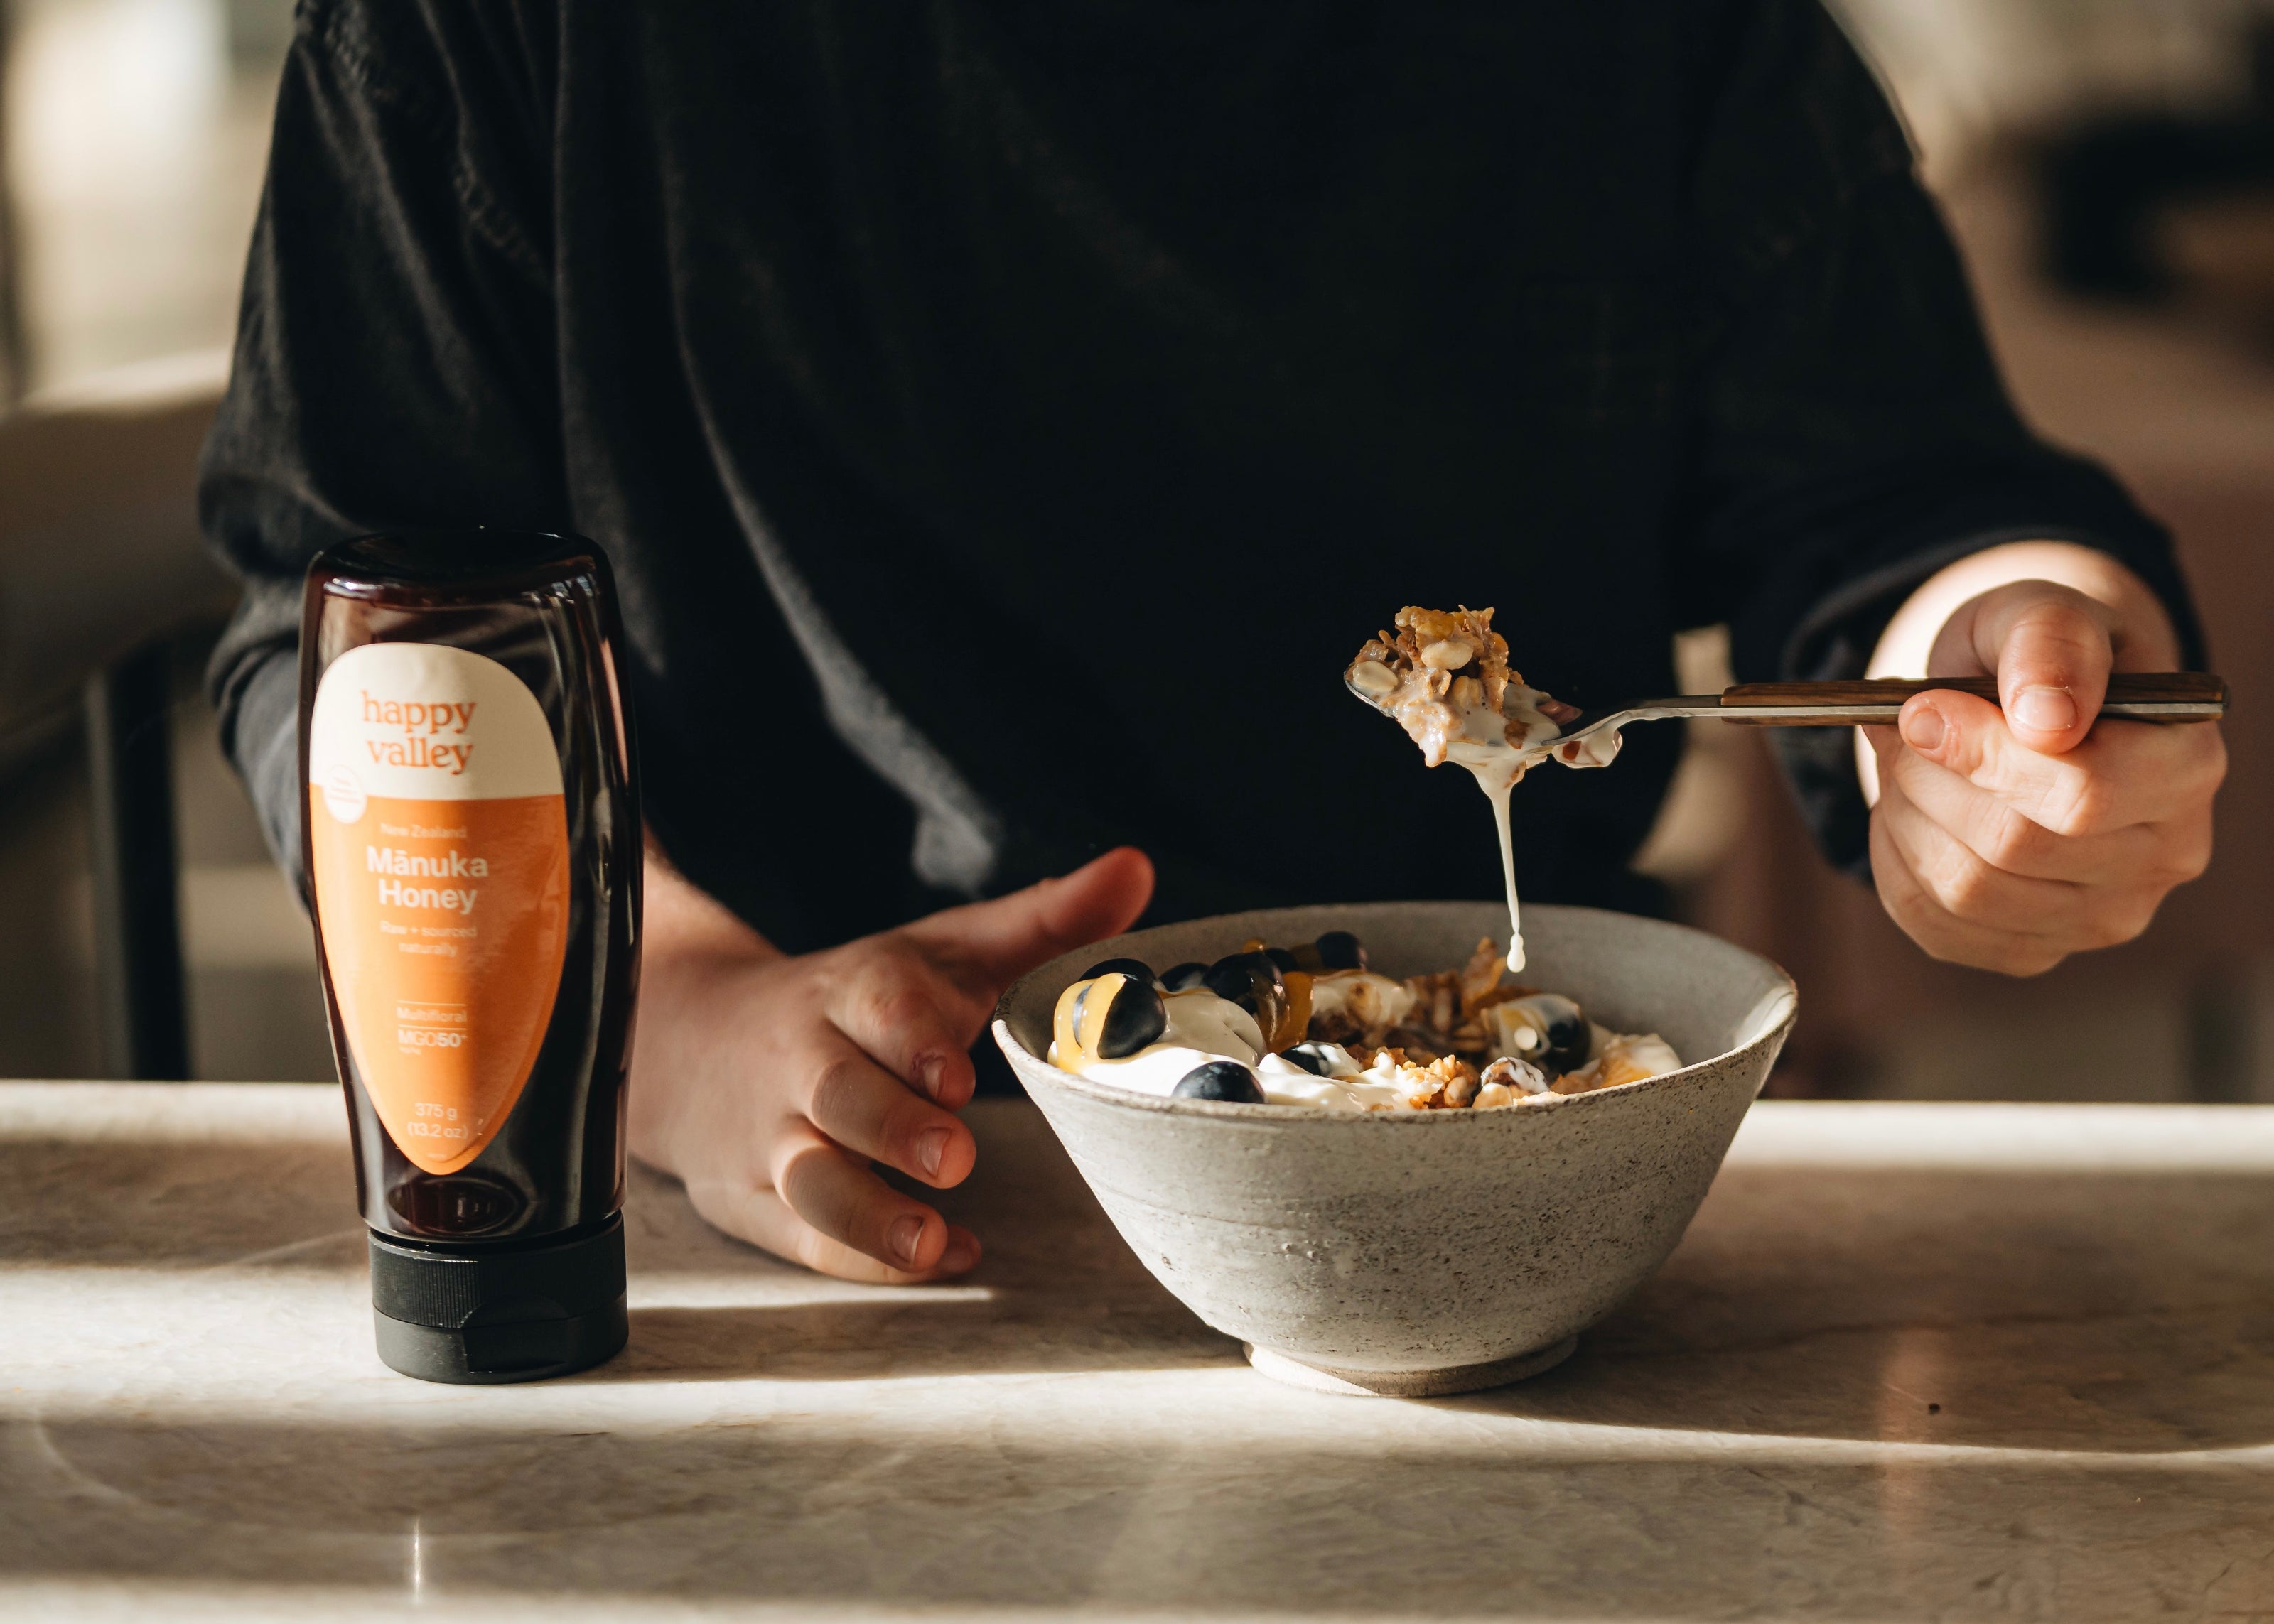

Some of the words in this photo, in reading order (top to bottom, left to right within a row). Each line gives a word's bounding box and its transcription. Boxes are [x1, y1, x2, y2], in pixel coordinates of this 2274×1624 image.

[361, 690, 477, 733] happy
[367, 737, 474, 775] valley
[380, 823, 409, 837] New
[410, 824, 468, 838] Zealand
[366, 845, 489, 877] Mānuka
[379, 879, 477, 914] Honey
[415, 1102, 443, 1118] 375
[446, 1108, 458, 1121] g
[406, 1121, 442, 1137] (13.2
[443, 1125, 469, 1140] oz)
